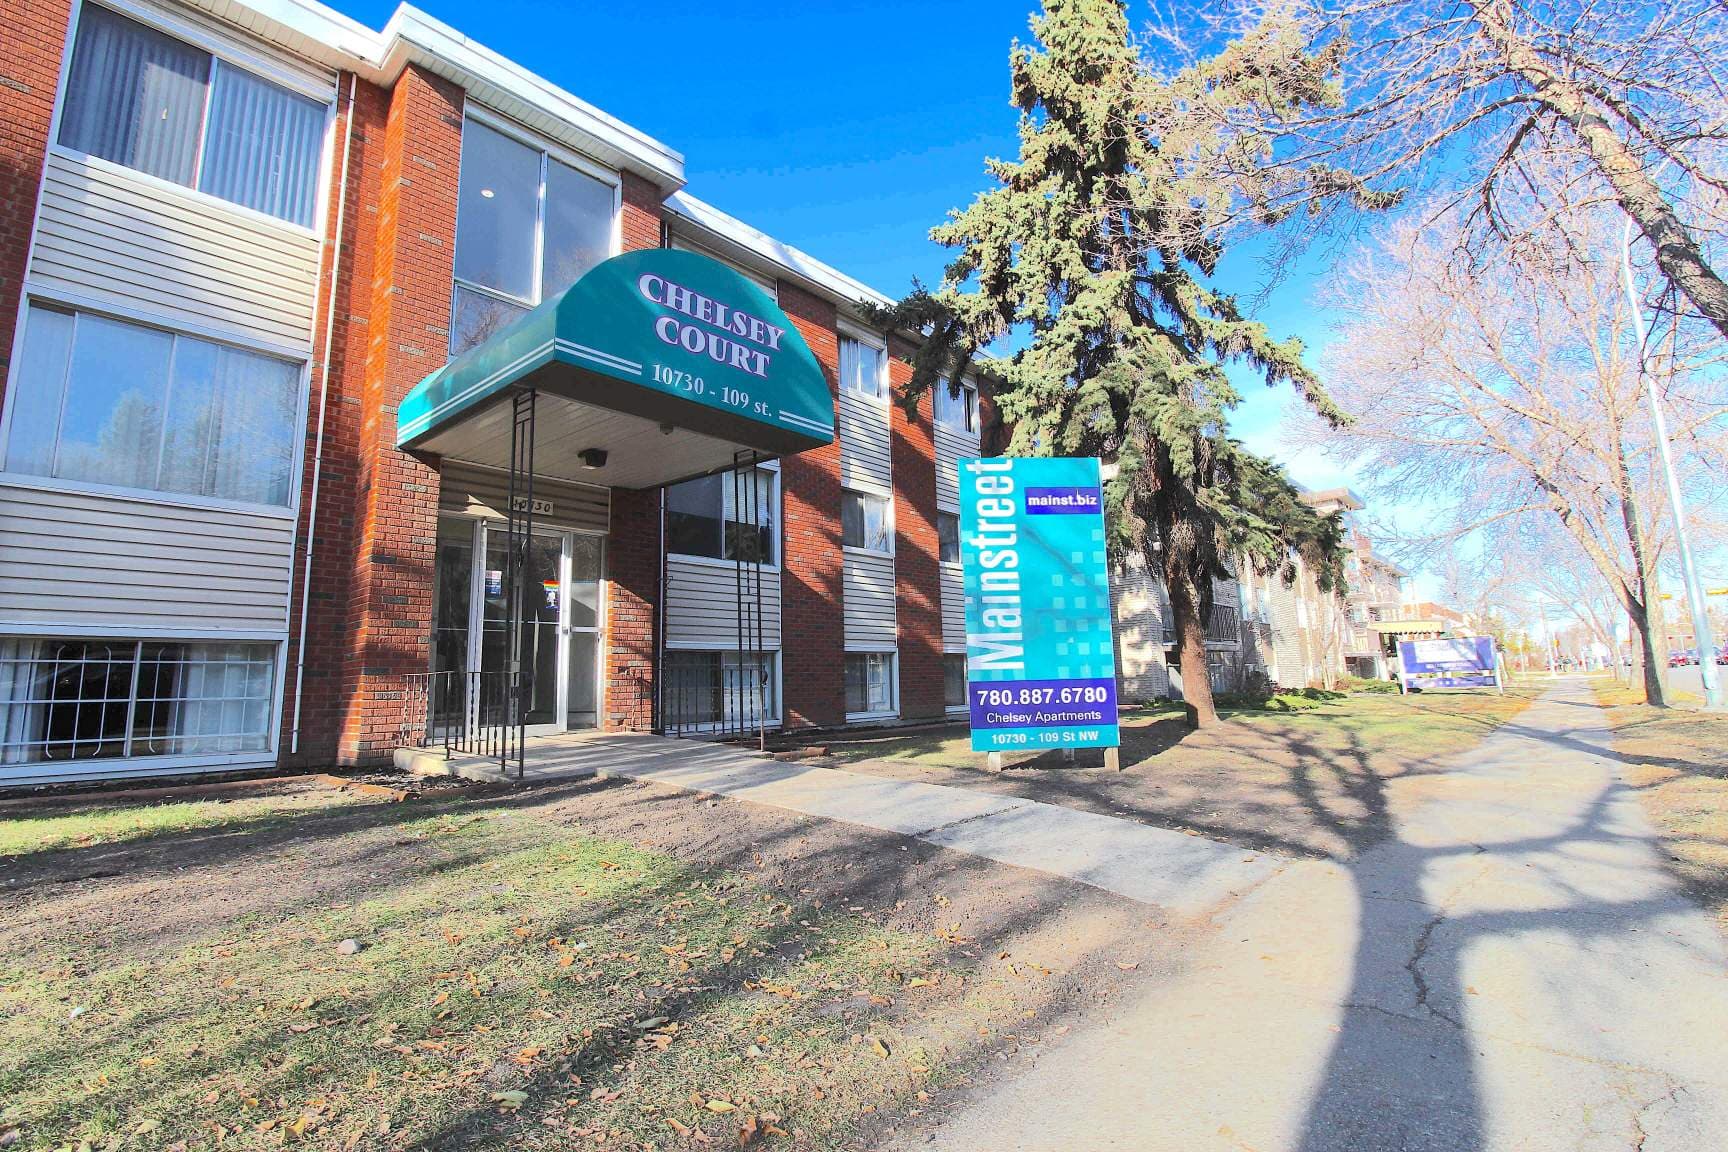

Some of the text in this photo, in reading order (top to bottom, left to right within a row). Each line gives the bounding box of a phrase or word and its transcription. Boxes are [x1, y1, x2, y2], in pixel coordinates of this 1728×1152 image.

[638, 273, 785, 350] CHELSEY
[655, 316, 770, 378] COURT
[652, 364, 704, 395] 10730
[721, 386, 749, 408] 109
[754, 401, 772, 416] st.
[1028, 494, 1098, 506] mainst.biz
[965, 458, 1025, 671] Mainstreet
[977, 686, 1107, 706] 780.887.6780
[986, 710, 1102, 724] Chelsey Apartments
[991, 733, 1026, 745] 10730
[1038, 732, 1059, 743] 109
[1063, 731, 1076, 742] St
[1079, 730, 1099, 742] NW
